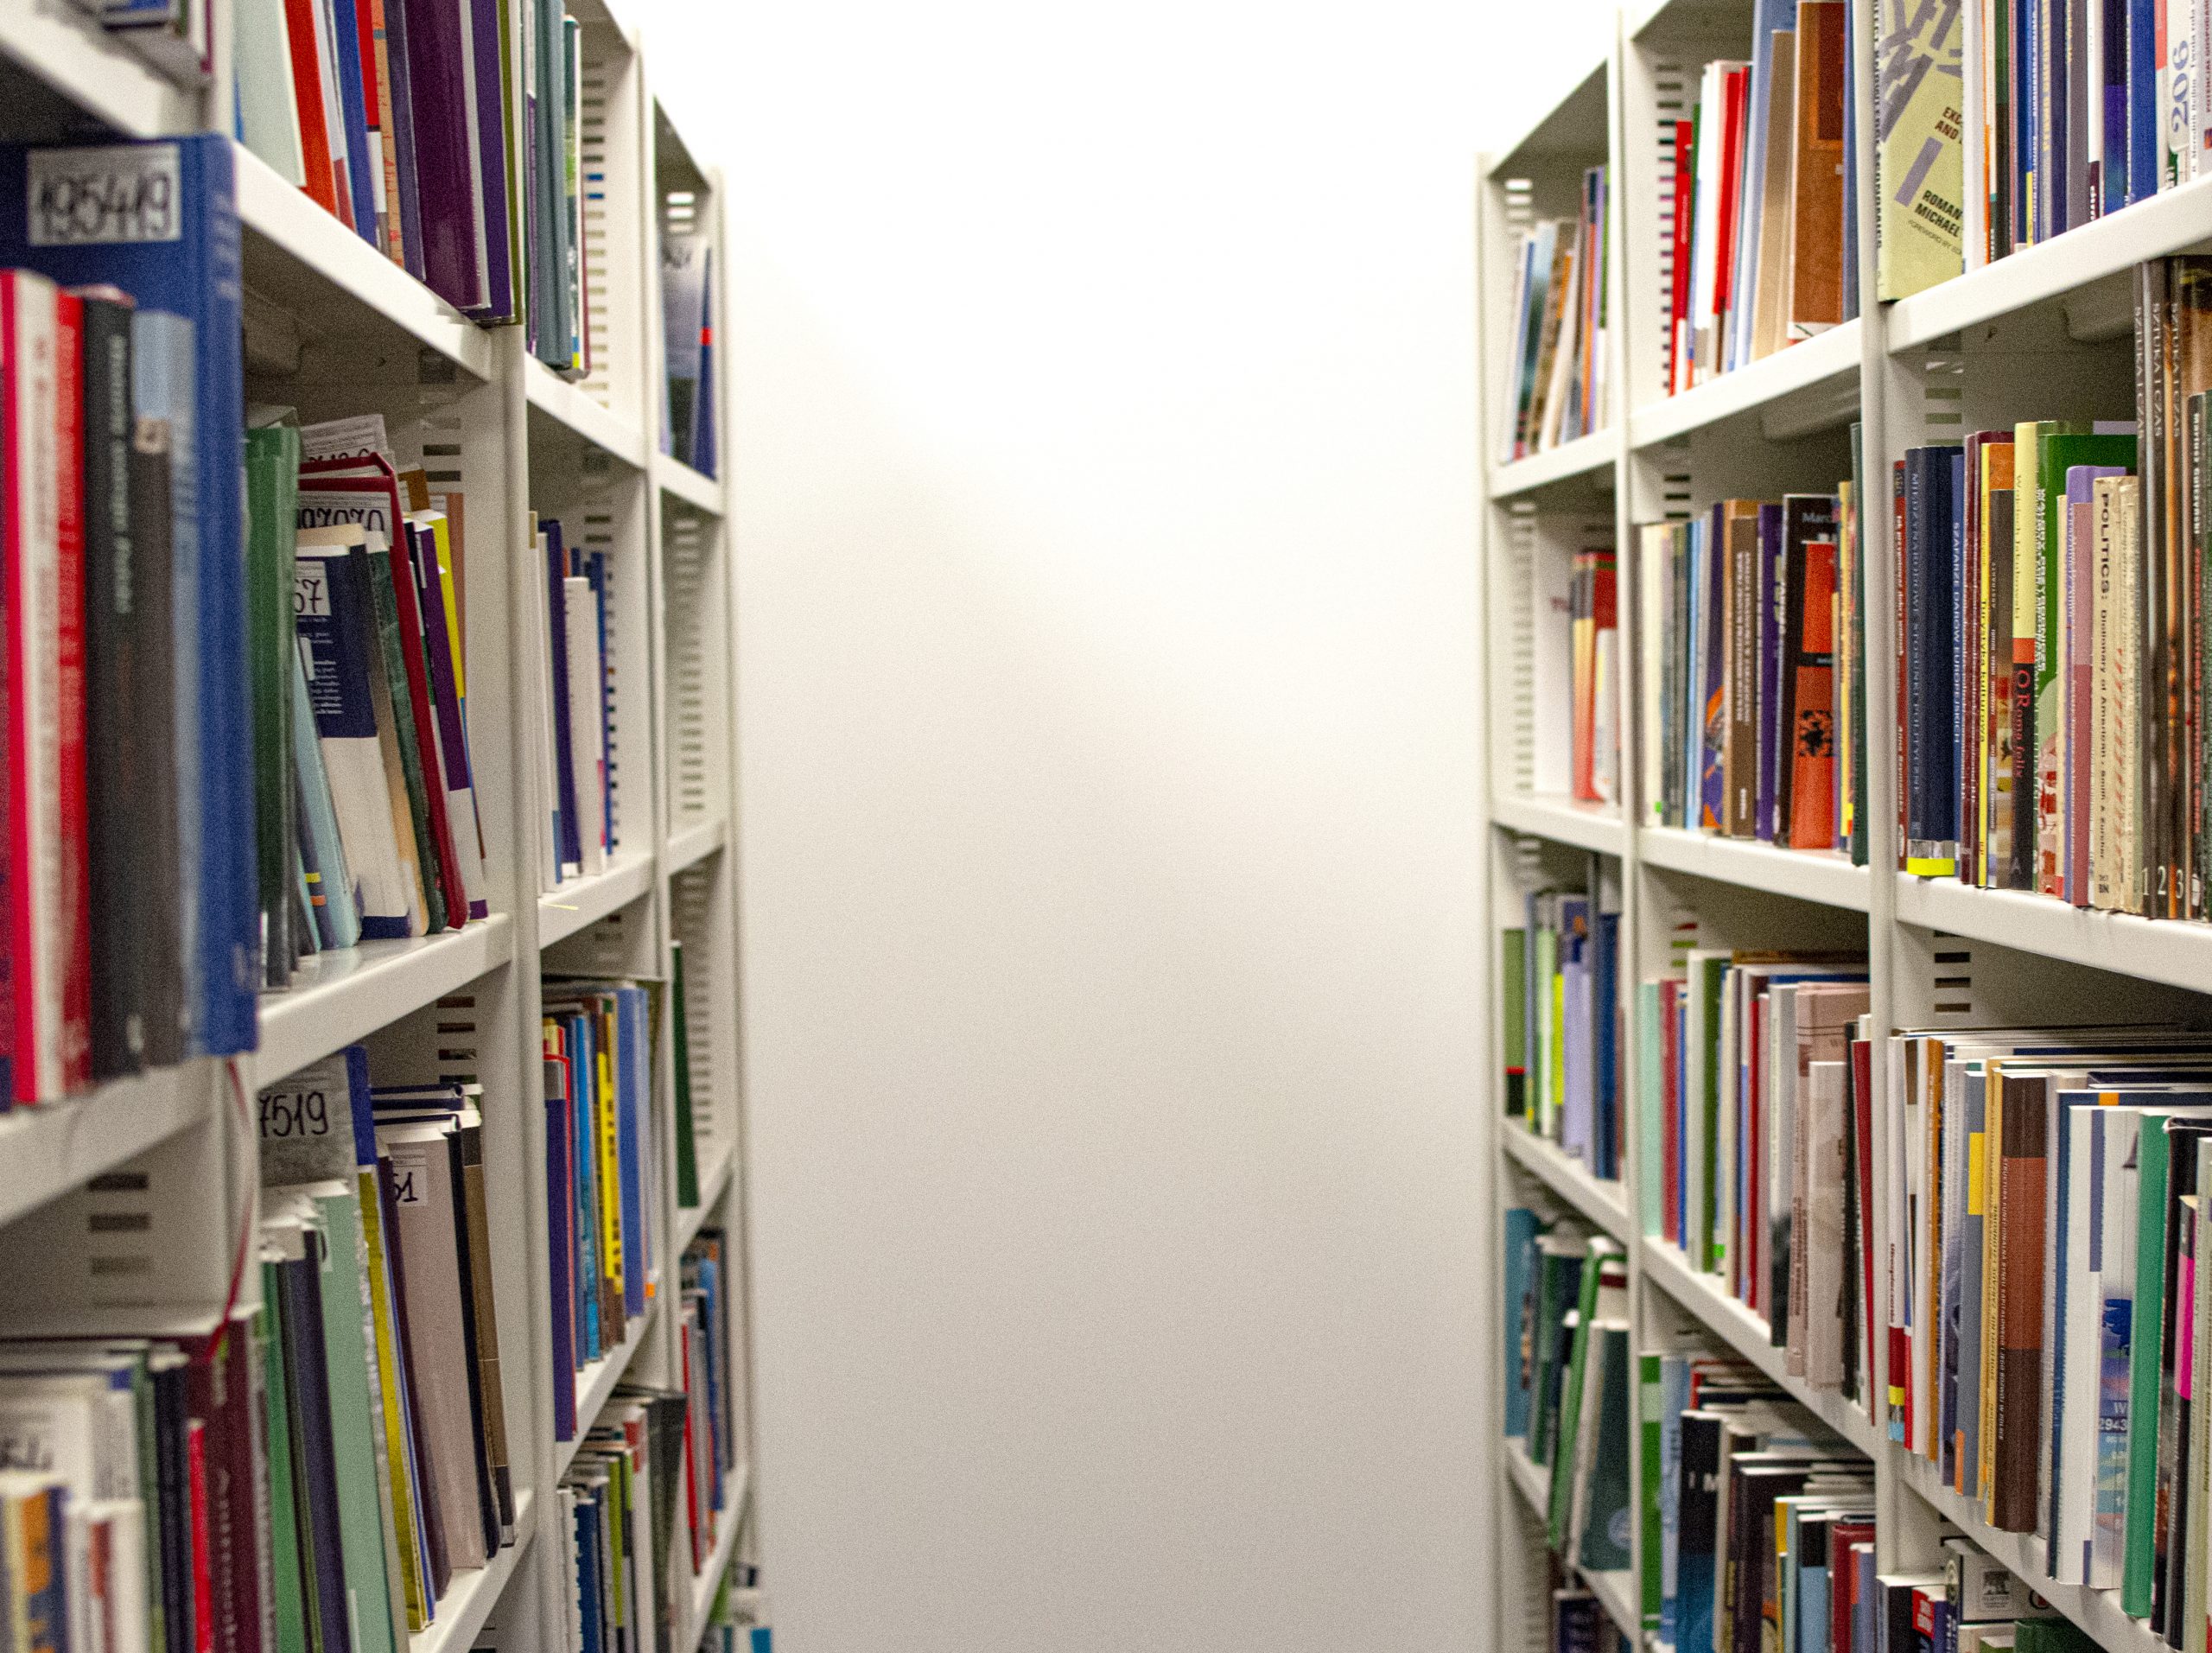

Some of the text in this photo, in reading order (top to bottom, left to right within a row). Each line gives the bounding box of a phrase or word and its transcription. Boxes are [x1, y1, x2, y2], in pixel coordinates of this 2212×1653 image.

[2171, 41, 2190, 133] 206
[1935, 120, 1959, 140] AND
[1914, 203, 1961, 238] MICHAEL
[1922, 189, 1962, 220] ROMAN
[2135, 307, 2144, 376] SZTUKA
[2152, 303, 2161, 373] SZTUKA
[2101, 493, 2110, 600] POLITICS:
[2099, 609, 2107, 672] Dictionary
[2015, 670, 2031, 779] O Roma felix
[2142, 867, 2150, 896] 1
[2158, 865, 2167, 895] 2
[2176, 869, 2184, 899] 3
[258, 1091, 329, 1138] 7519
